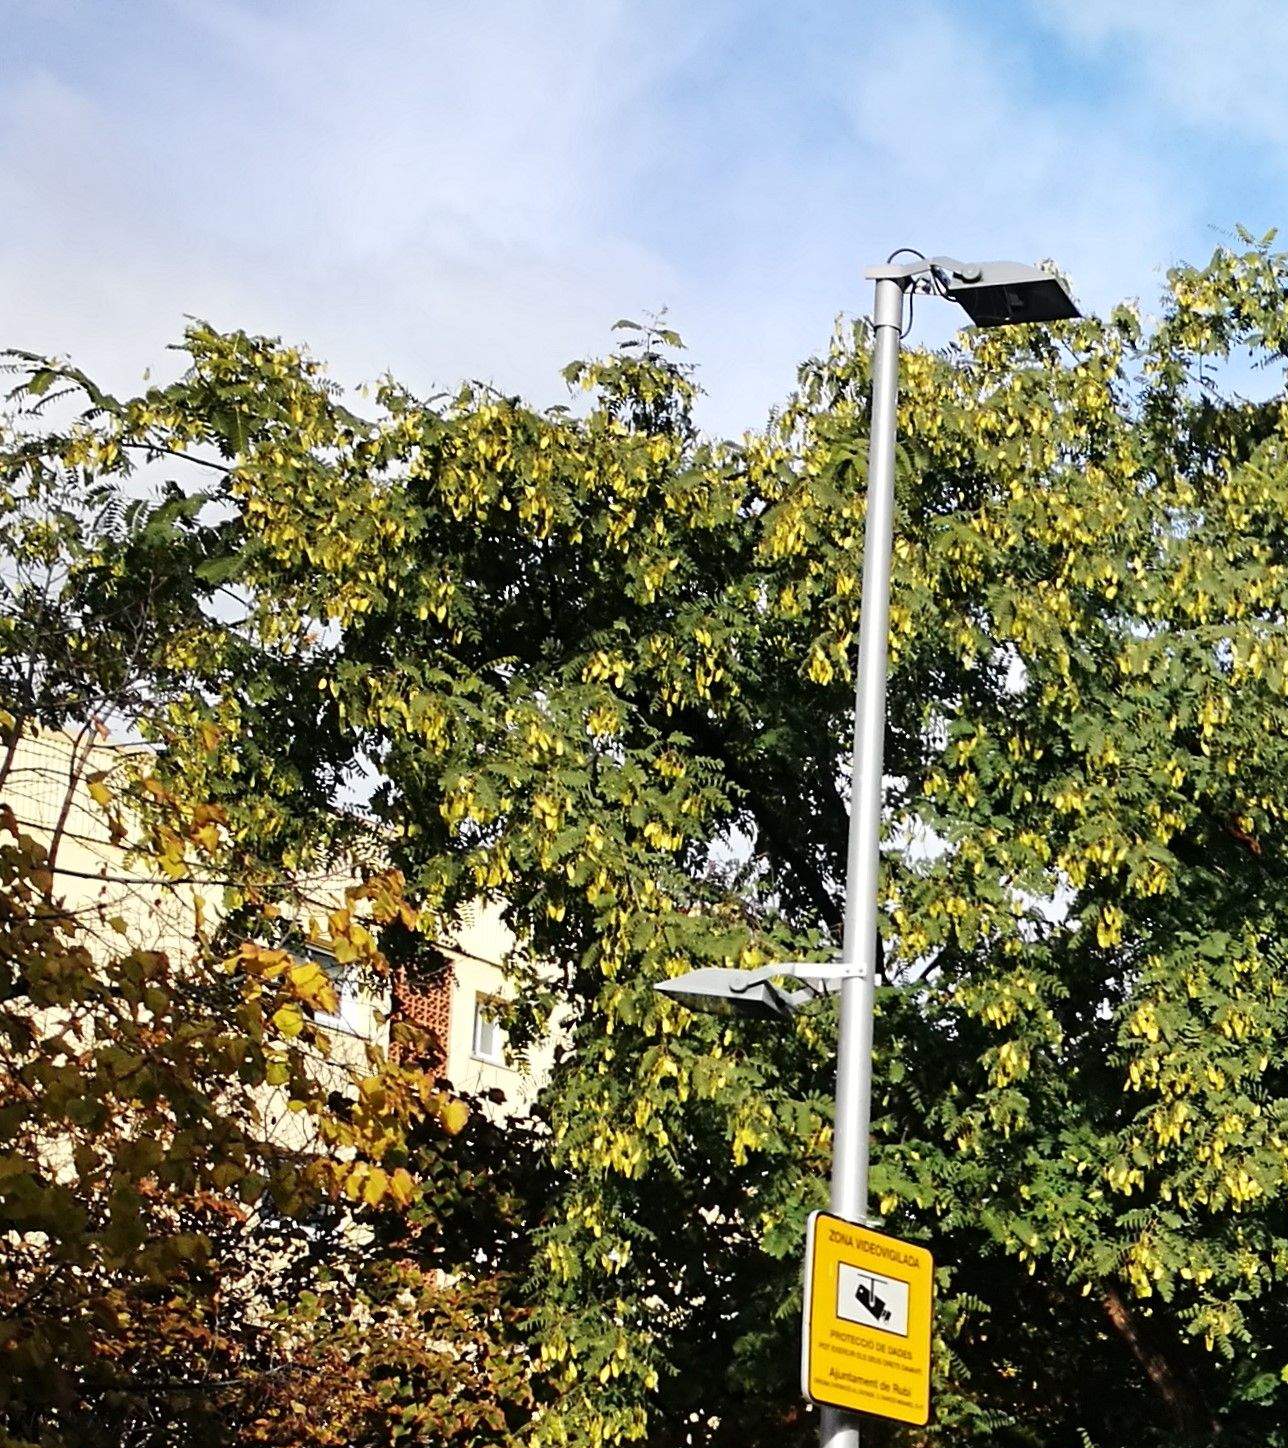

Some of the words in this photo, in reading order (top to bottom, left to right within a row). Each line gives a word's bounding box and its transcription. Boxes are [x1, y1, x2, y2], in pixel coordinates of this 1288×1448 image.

[829, 1229, 854, 1248] ZONA
[856, 1238, 920, 1268] VIDEOVIGILADA
[876, 1342, 885, 1354] DE
[829, 1367, 878, 1389] Ajuntament
[879, 1381, 891, 1393] de
